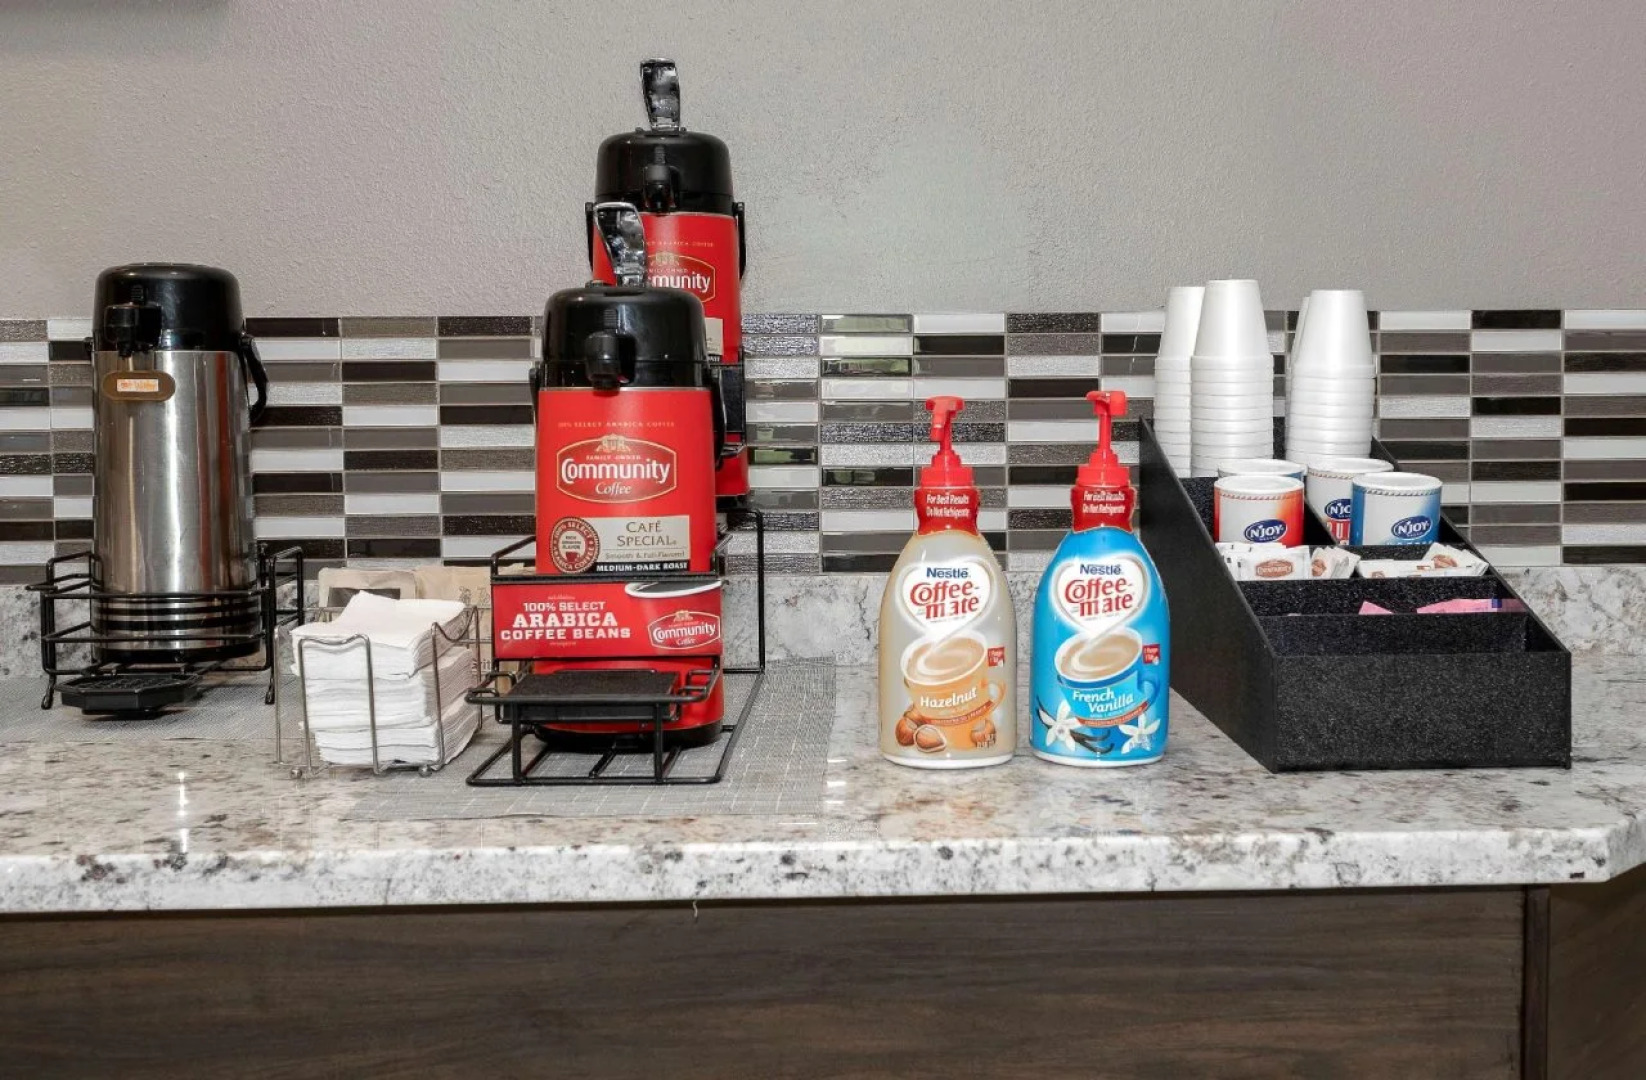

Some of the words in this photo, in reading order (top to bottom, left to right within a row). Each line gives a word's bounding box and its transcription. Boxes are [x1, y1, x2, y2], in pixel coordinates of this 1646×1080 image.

[651, 271, 711, 293] munity
[561, 458, 670, 484] Community
[595, 481, 632, 496] Coffee
[596, 563, 661, 572] MEDIUM-DARK
[663, 562, 688, 571] ROAST
[523, 602, 556, 612] 100%
[558, 601, 606, 611] SELECT
[925, 596, 979, 619] mate
[1080, 593, 1133, 616] mate
[512, 612, 618, 628] ARABICA
[500, 629, 567, 640] COFFEE
[572, 627, 631, 639] BEANS
[653, 621, 716, 643] Community
[920, 687, 977, 708] Hazelnut
[1073, 687, 1115, 703] French
[1088, 693, 1134, 713] Vanilla
